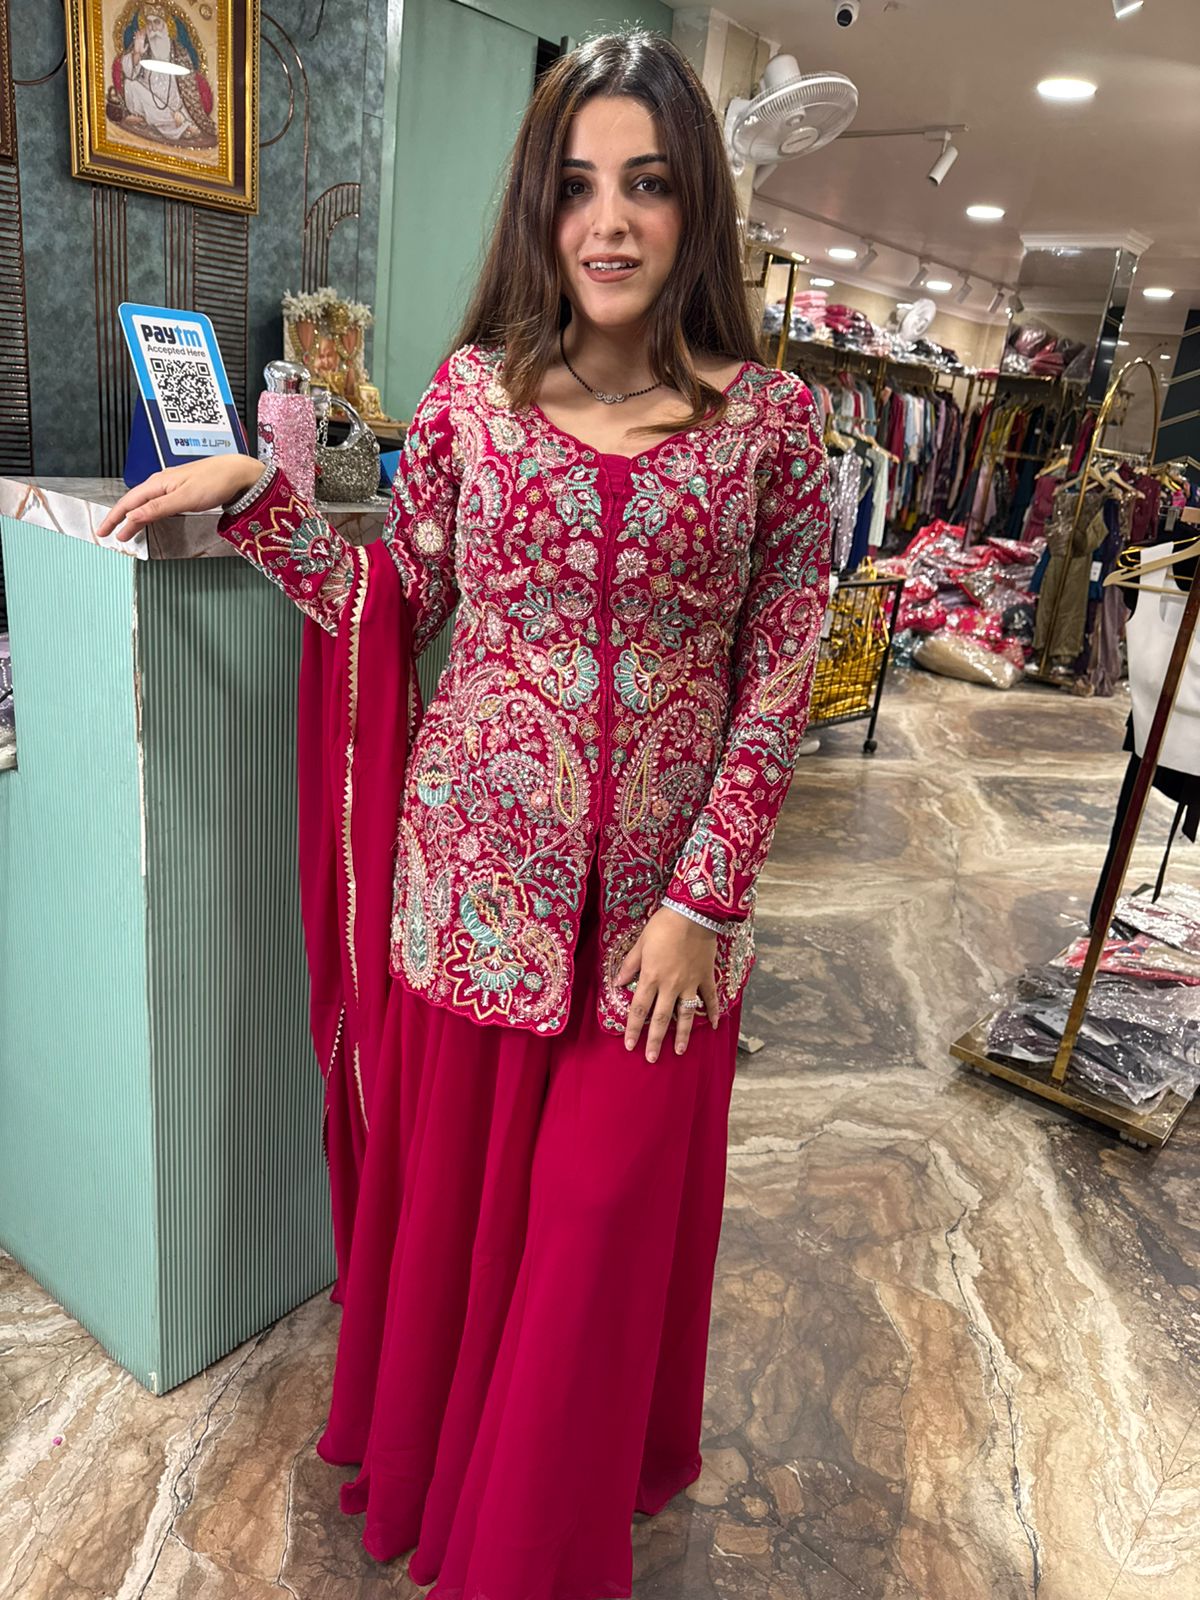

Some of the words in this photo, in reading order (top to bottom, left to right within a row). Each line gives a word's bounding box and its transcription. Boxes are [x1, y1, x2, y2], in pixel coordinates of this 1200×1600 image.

[141, 324, 202, 348] paytm
[147, 344, 186, 356] Accepted
[186, 348, 206, 358] Here
